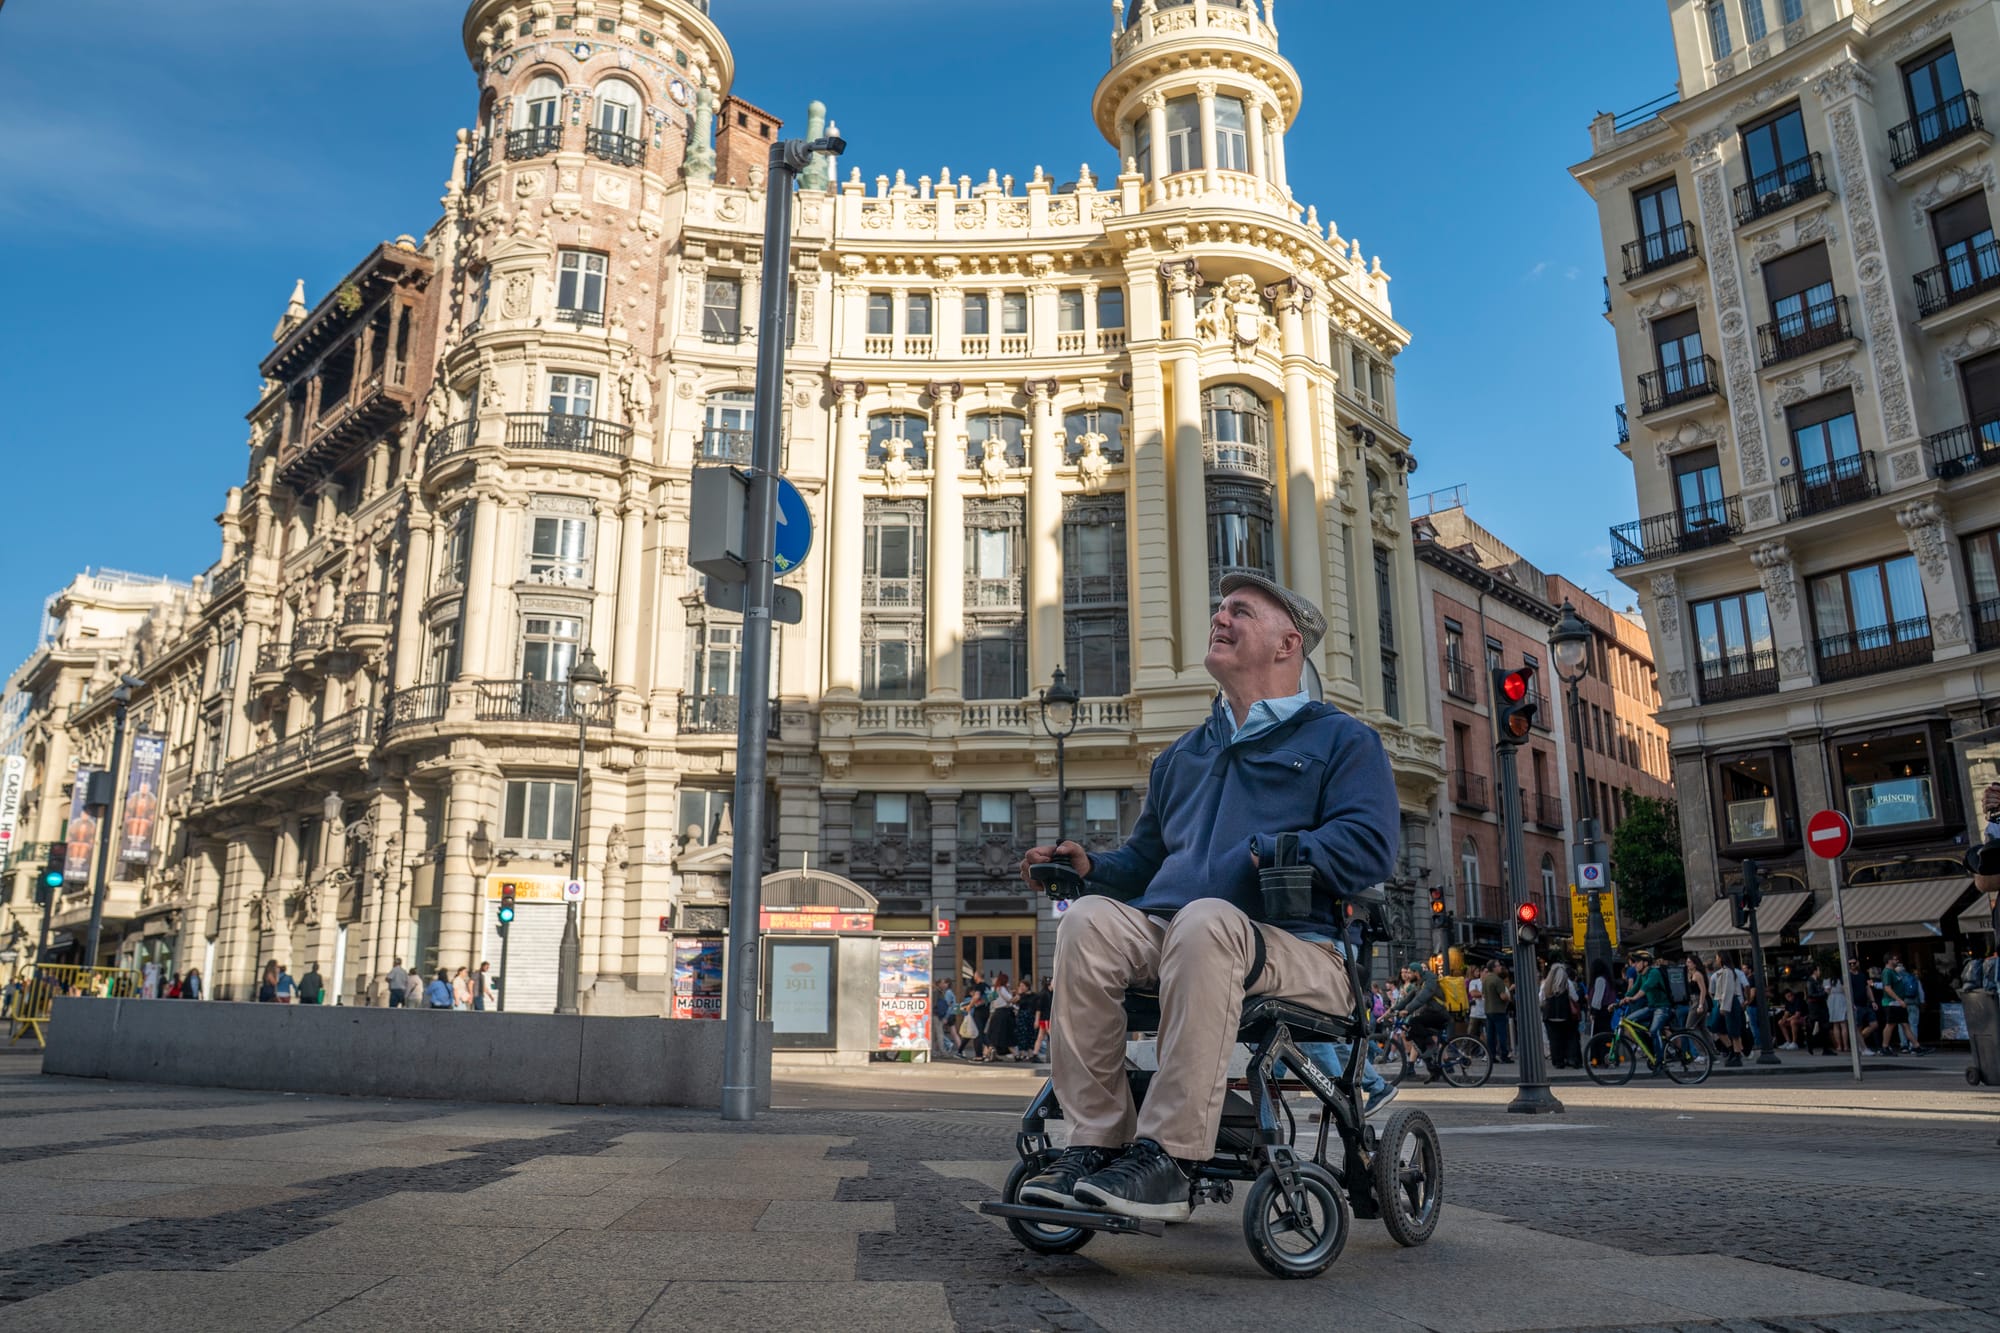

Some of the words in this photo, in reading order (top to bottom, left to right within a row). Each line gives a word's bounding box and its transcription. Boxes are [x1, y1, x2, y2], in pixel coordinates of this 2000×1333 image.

[3, 773, 19, 817] CASUAL
[784, 977, 816, 992] 1911
[677, 998, 722, 1009] MADRID
[881, 1000, 926, 1010] MADRID
[1303, 1057, 1335, 1097] Jazzy
